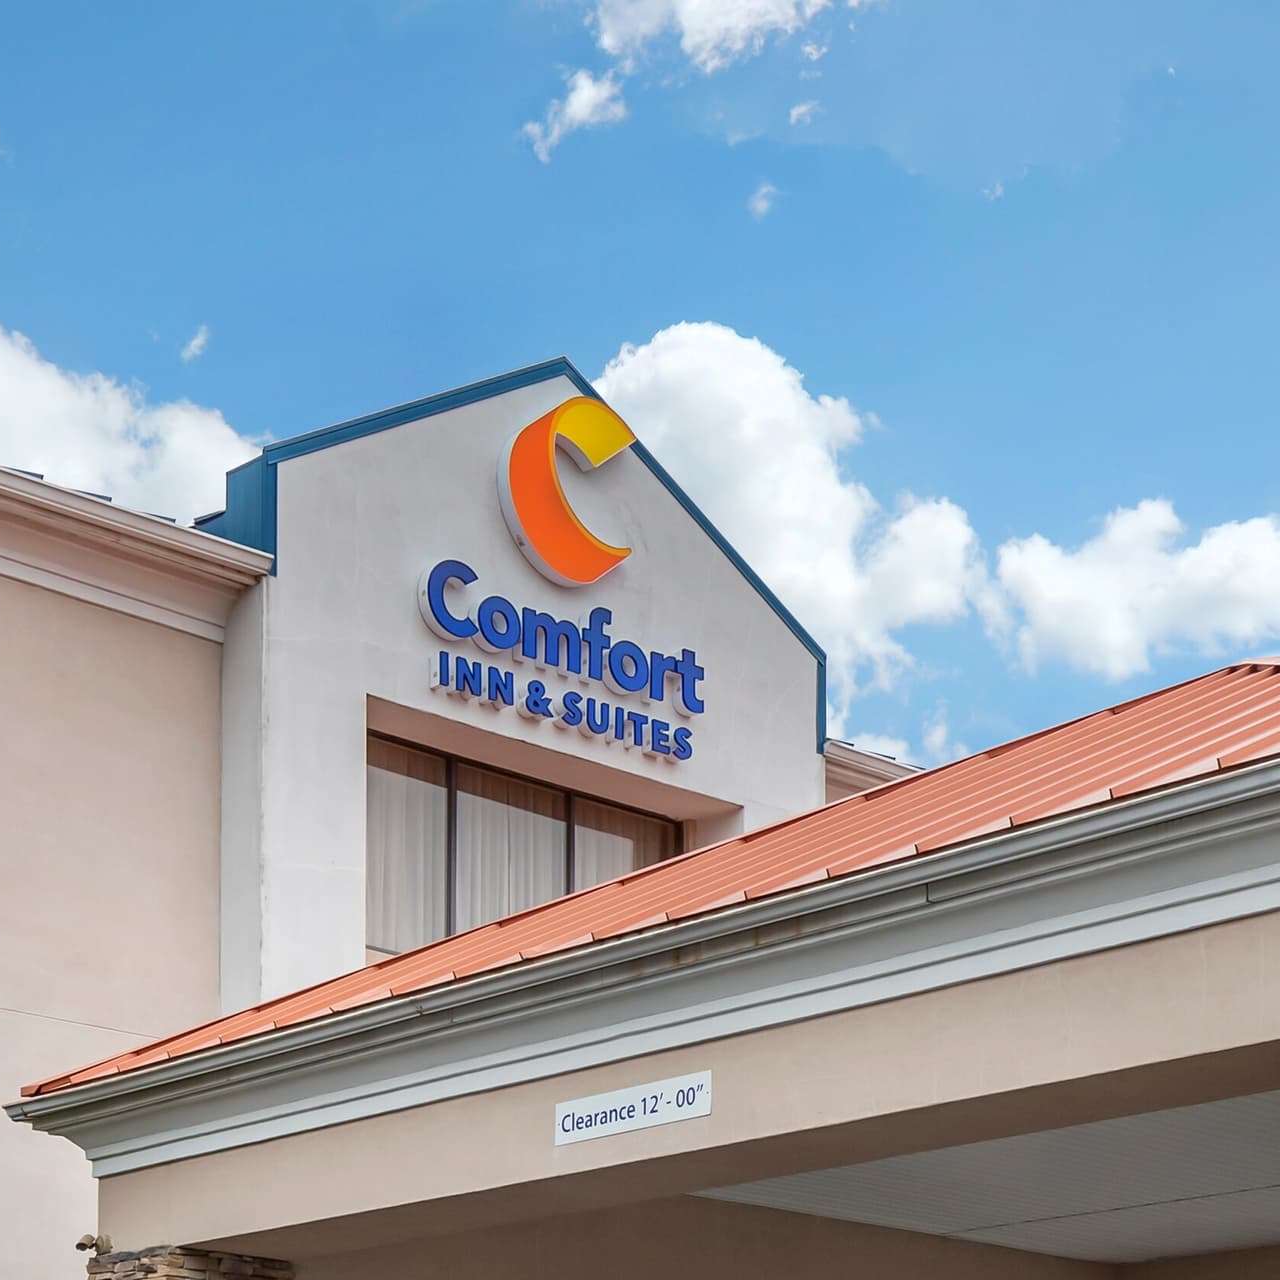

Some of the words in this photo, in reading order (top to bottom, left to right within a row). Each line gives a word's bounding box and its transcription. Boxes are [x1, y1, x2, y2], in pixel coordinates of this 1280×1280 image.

[425, 558, 705, 714] Comfort
[438, 650, 514, 706] INN
[525, 679, 554, 718] &
[561, 691, 694, 761] SUITES
[561, 1103, 636, 1133] Clearance
